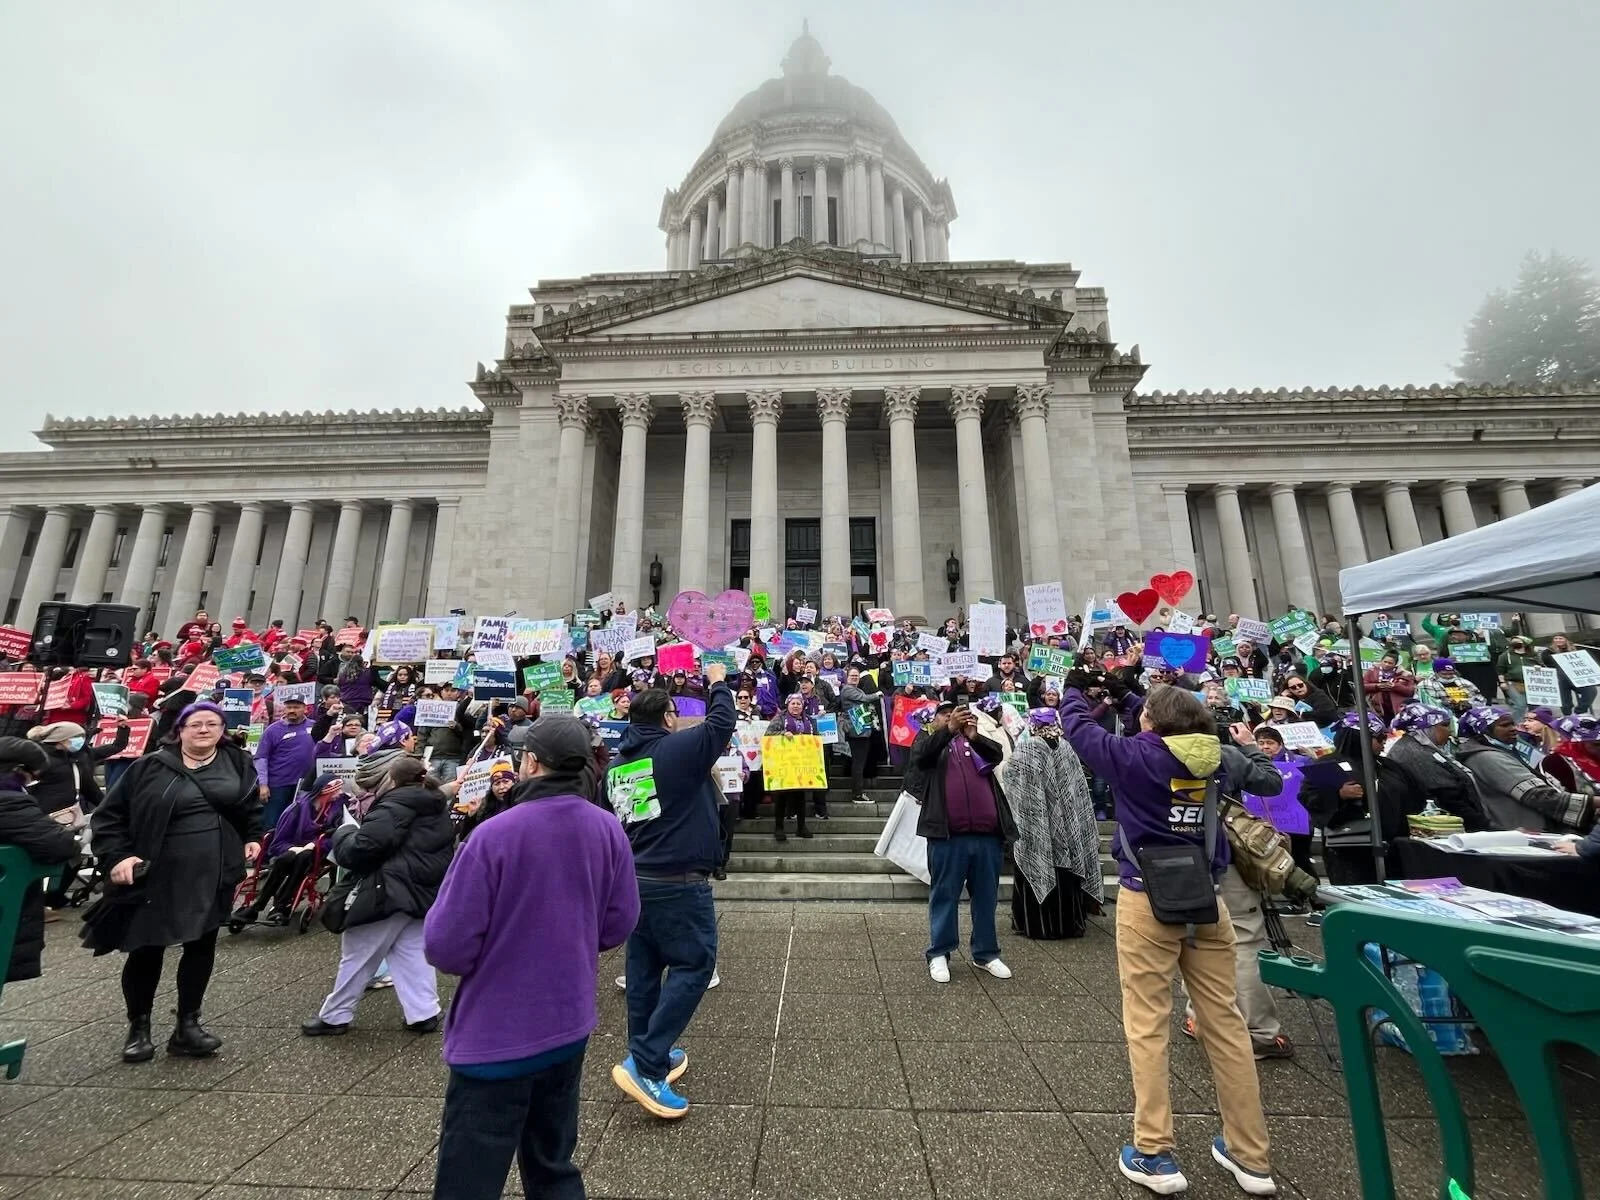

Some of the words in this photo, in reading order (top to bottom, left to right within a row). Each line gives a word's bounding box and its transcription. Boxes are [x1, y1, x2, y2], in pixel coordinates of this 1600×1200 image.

[665, 360, 801, 375] LEGISLATIVE
[831, 356, 935, 370] BUILDING
[481, 619, 509, 629] FAMIL
[1036, 648, 1048, 658] TAX
[1052, 654, 1063, 664] THE
[1569, 660, 1587, 668] THE
[913, 665, 922, 674] THE
[1573, 668, 1595, 677] RICH
[915, 675, 929, 684] RICH
[1529, 677, 1553, 686] PUBLIC
[505, 681, 515, 689] Tax
[1254, 681, 1268, 690] THE
[1248, 689, 1267, 699] RICH
[1527, 685, 1558, 695] SERVICES
[469, 767, 483, 775] AKE
[463, 771, 491, 782] MILLION
[463, 781, 478, 789] PAY
[464, 785, 487, 795] SHARE
[1168, 805, 1204, 823] SEI
[1170, 824, 1198, 834] Leading
